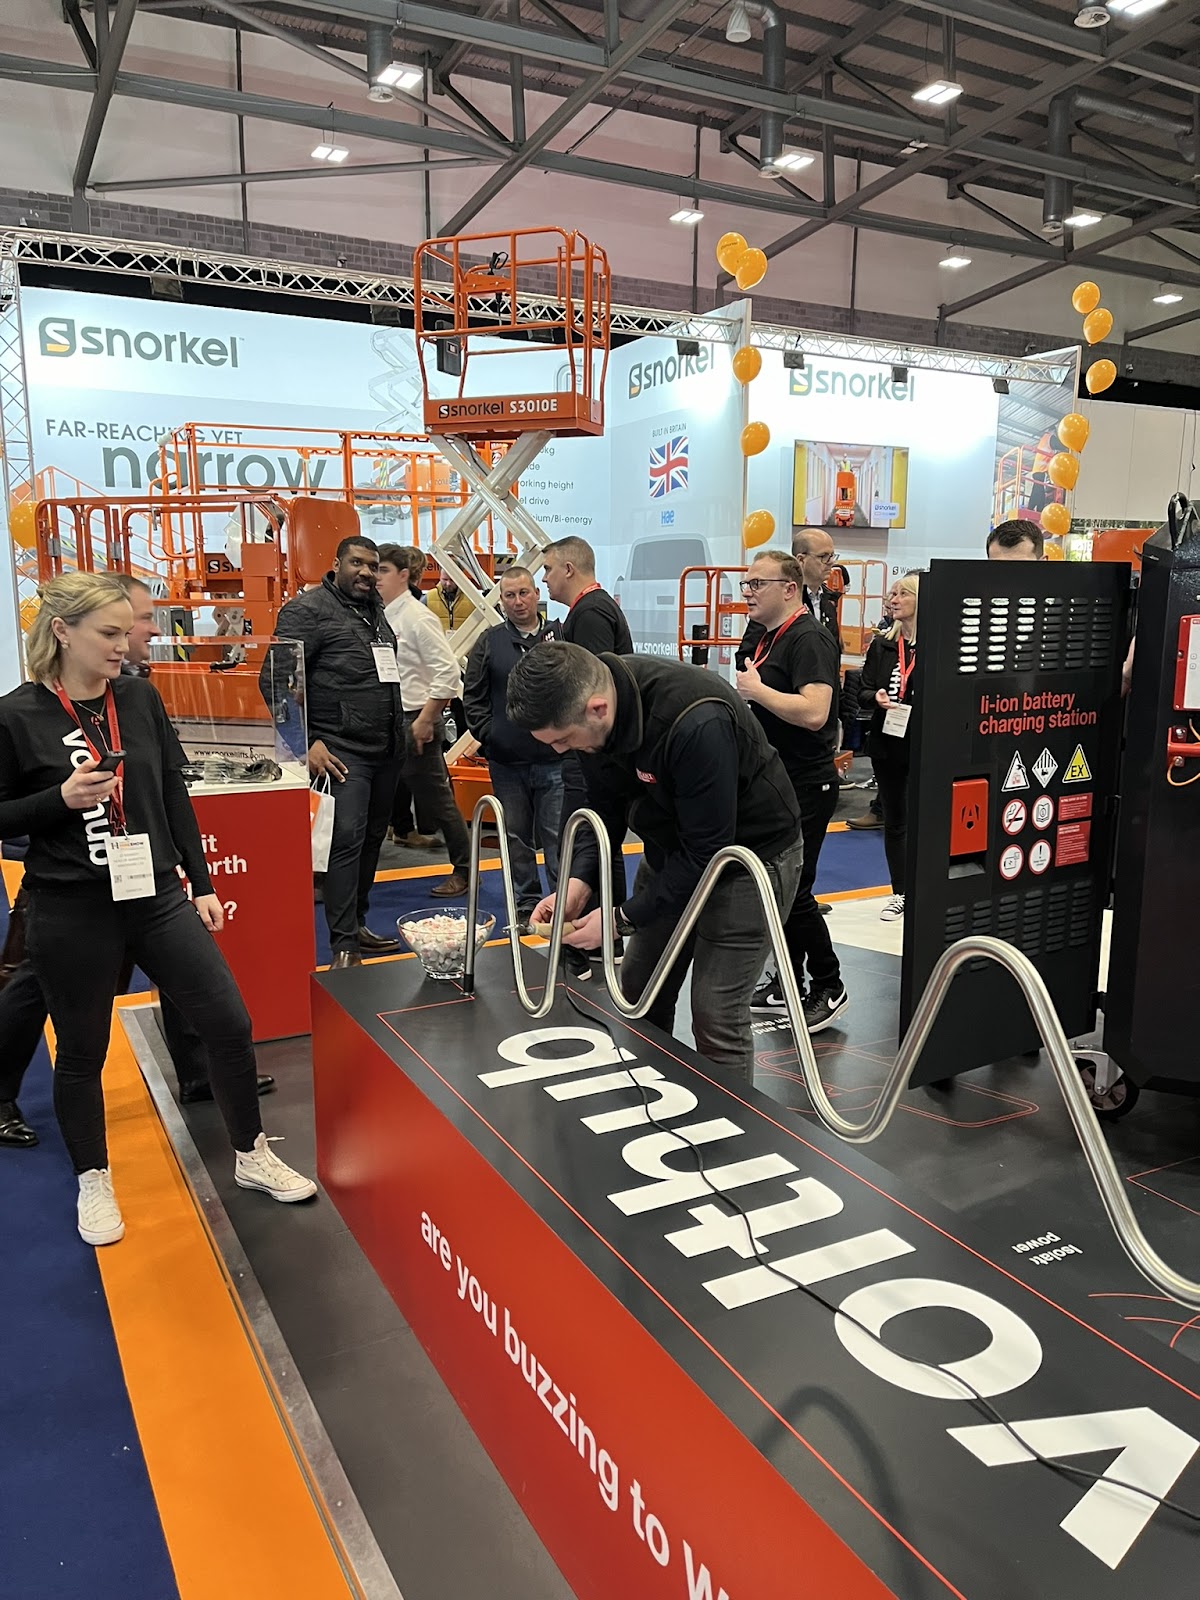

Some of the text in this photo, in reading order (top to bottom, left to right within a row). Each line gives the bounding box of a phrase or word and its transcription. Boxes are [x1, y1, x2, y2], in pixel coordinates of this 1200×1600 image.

[81, 326, 239, 368] snorkel
[643, 342, 714, 390] snorkel
[815, 370, 915, 401] snorkel
[451, 398, 558, 416] snorkel S3010E
[102, 446, 327, 496] narrow
[518, 480, 574, 490] orking height
[528, 497, 550, 505] drive
[980, 691, 1076, 714] li-ion battery
[979, 708, 1097, 736] charging station
[1070, 765, 1085, 777] EX
[477, 1026, 1200, 1569] volthub
[421, 1211, 452, 1271] are
[456, 1255, 497, 1337] you
[504, 1308, 619, 1512] buzzing
[630, 1479, 670, 1567] to
